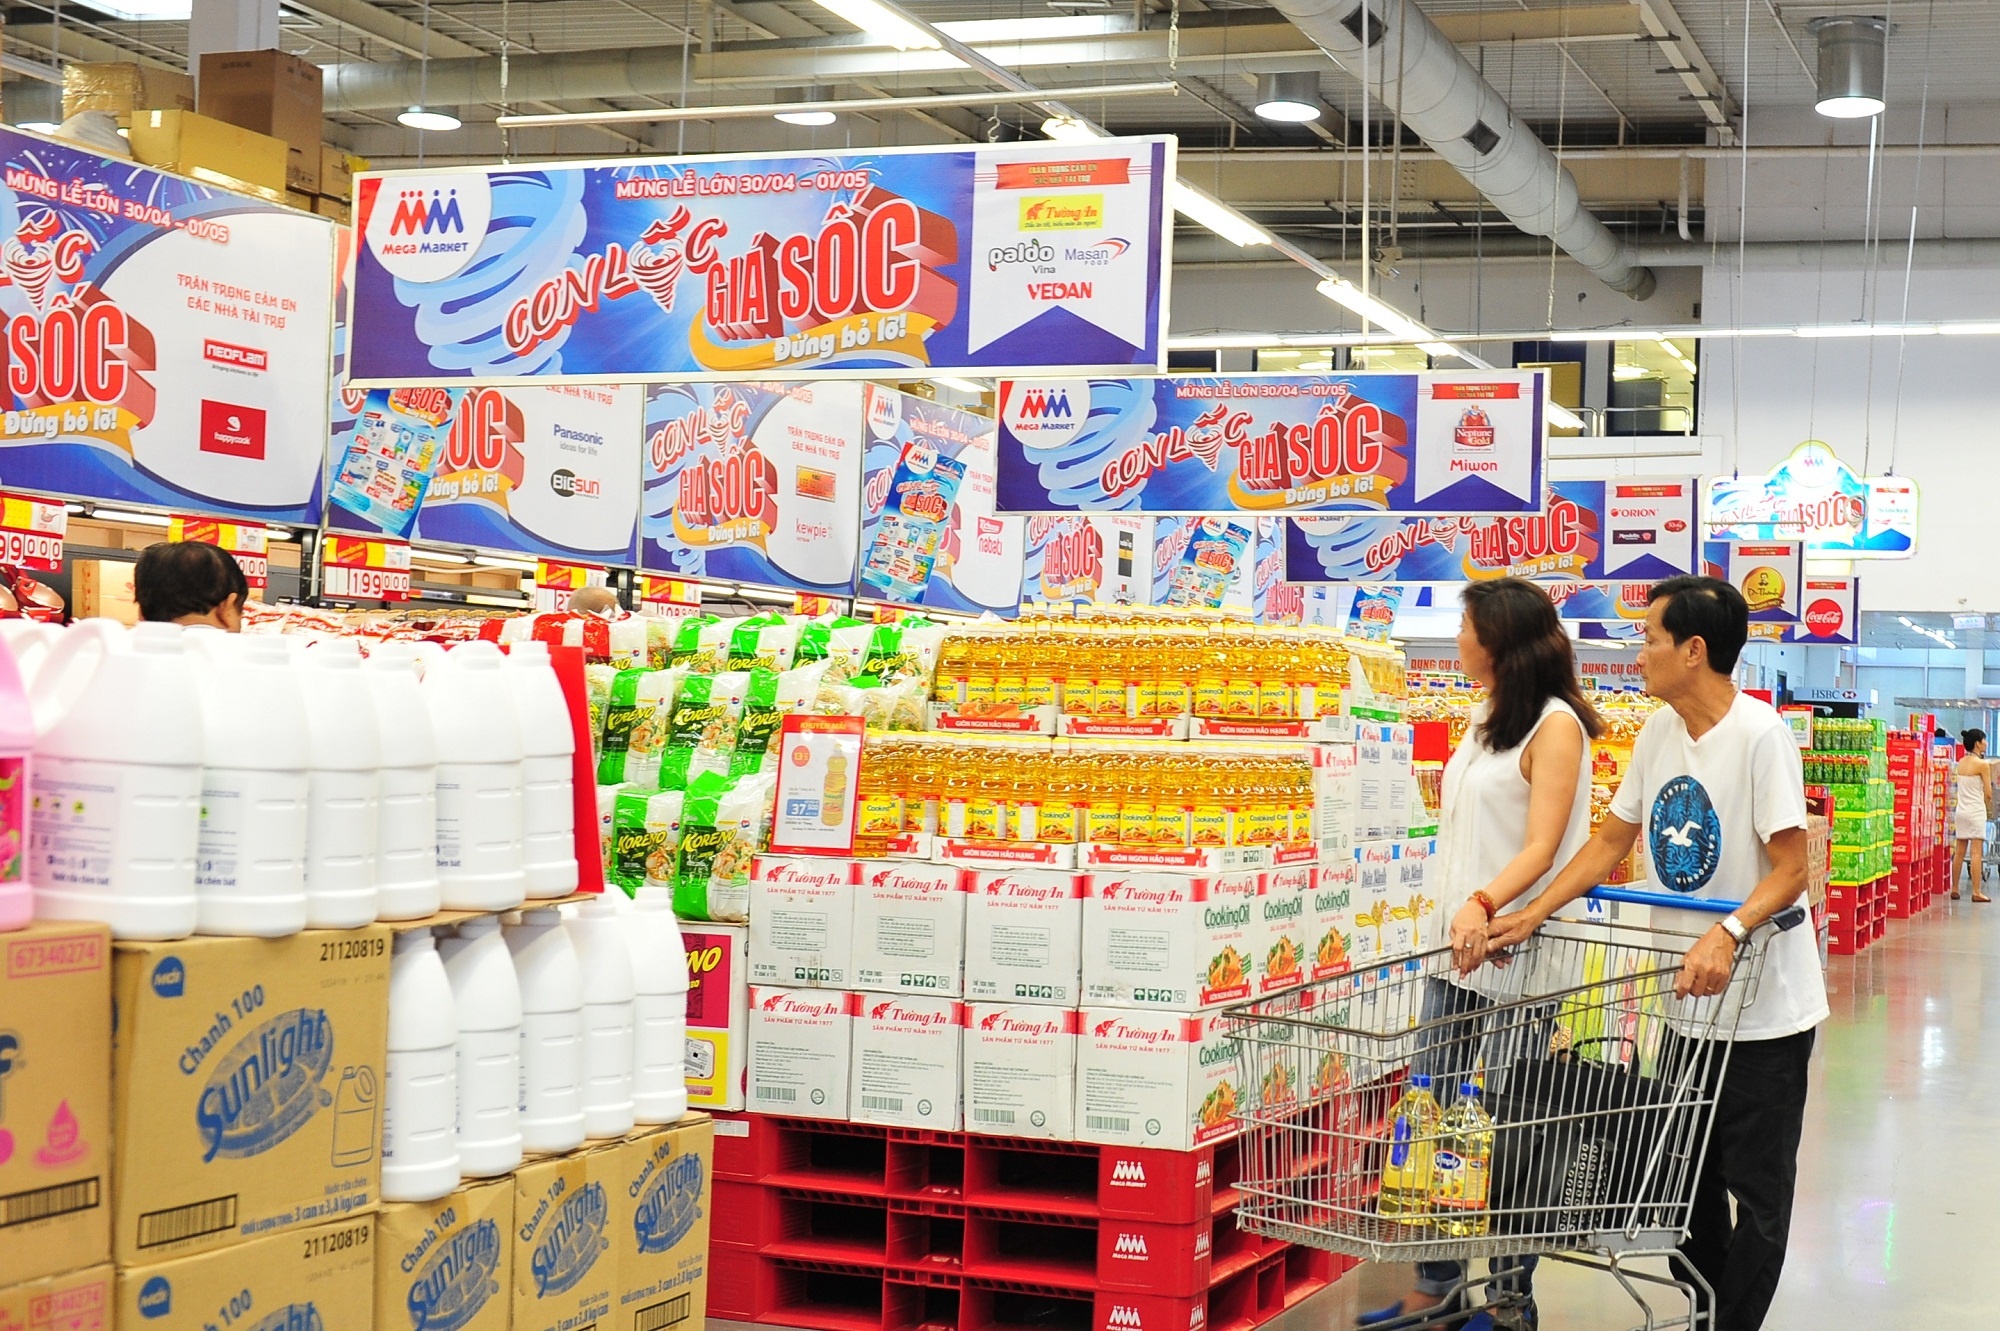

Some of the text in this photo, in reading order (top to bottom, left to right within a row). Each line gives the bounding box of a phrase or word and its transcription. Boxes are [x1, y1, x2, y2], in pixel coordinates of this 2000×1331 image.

[616, 169, 868, 199] MỪNG LỄ LỚN 30/04 01/05
[6, 169, 229, 243] MỪNG LỄ LỚN 30/04 01/05
[706, 183, 921, 328] GIÁ SỐC
[988, 238, 1055, 272] paldo
[1065, 248, 1109, 261] Masan
[1032, 265, 1056, 274] Vina
[1027, 282, 1092, 300] VEDAN
[504, 253, 601, 356] CƠN
[8, 282, 130, 404] SỐC
[774, 334, 835, 362] Đừng
[840, 320, 872, 348] bỏ
[1177, 380, 1347, 398] MỪNG LỄ LỚN 30/04 01/05
[4, 407, 59, 438] Đừng
[63, 406, 90, 434] bỏ
[553, 423, 604, 446] Panasonic
[1239, 393, 1383, 482] GIÁ SỐC
[678, 437, 766, 519] GIÁ SỐC
[1101, 432, 1169, 498] CƠN
[1450, 459, 1498, 471] Miwon
[1621, 508, 1656, 517] ORION
[796, 518, 828, 543] kewpie
[1581, 662, 1625, 677] DỤNG CỤ
[1811, 689, 1840, 699] HSBC
[607, 706, 655, 731] KORENO
[673, 704, 727, 731] KORENO
[791, 803, 806, 815] 37
[617, 830, 668, 854] KORENO
[681, 829, 738, 852] KORENO
[786, 870, 826, 887] Tường
[892, 876, 932, 893] Tường
[1007, 884, 1047, 900] Tường
[1124, 887, 1165, 904] Tường
[1204, 904, 1250, 930] CookingOil
[1263, 896, 1304, 922] CookingOil
[320, 938, 385, 963] 21120819
[178, 984, 264, 1076] Chanh 100
[196, 1007, 328, 1164] Sunlight
[628, 1141, 671, 1199] Chanh 100
[519, 1176, 566, 1242] Chanh 100
[633, 1152, 700, 1254] Sunlight
[303, 1225, 370, 1259] 21120819
[401, 1207, 456, 1274] Chanh 100
[531, 1181, 603, 1299] Sunlight
[406, 1218, 497, 1331] Sunlight
